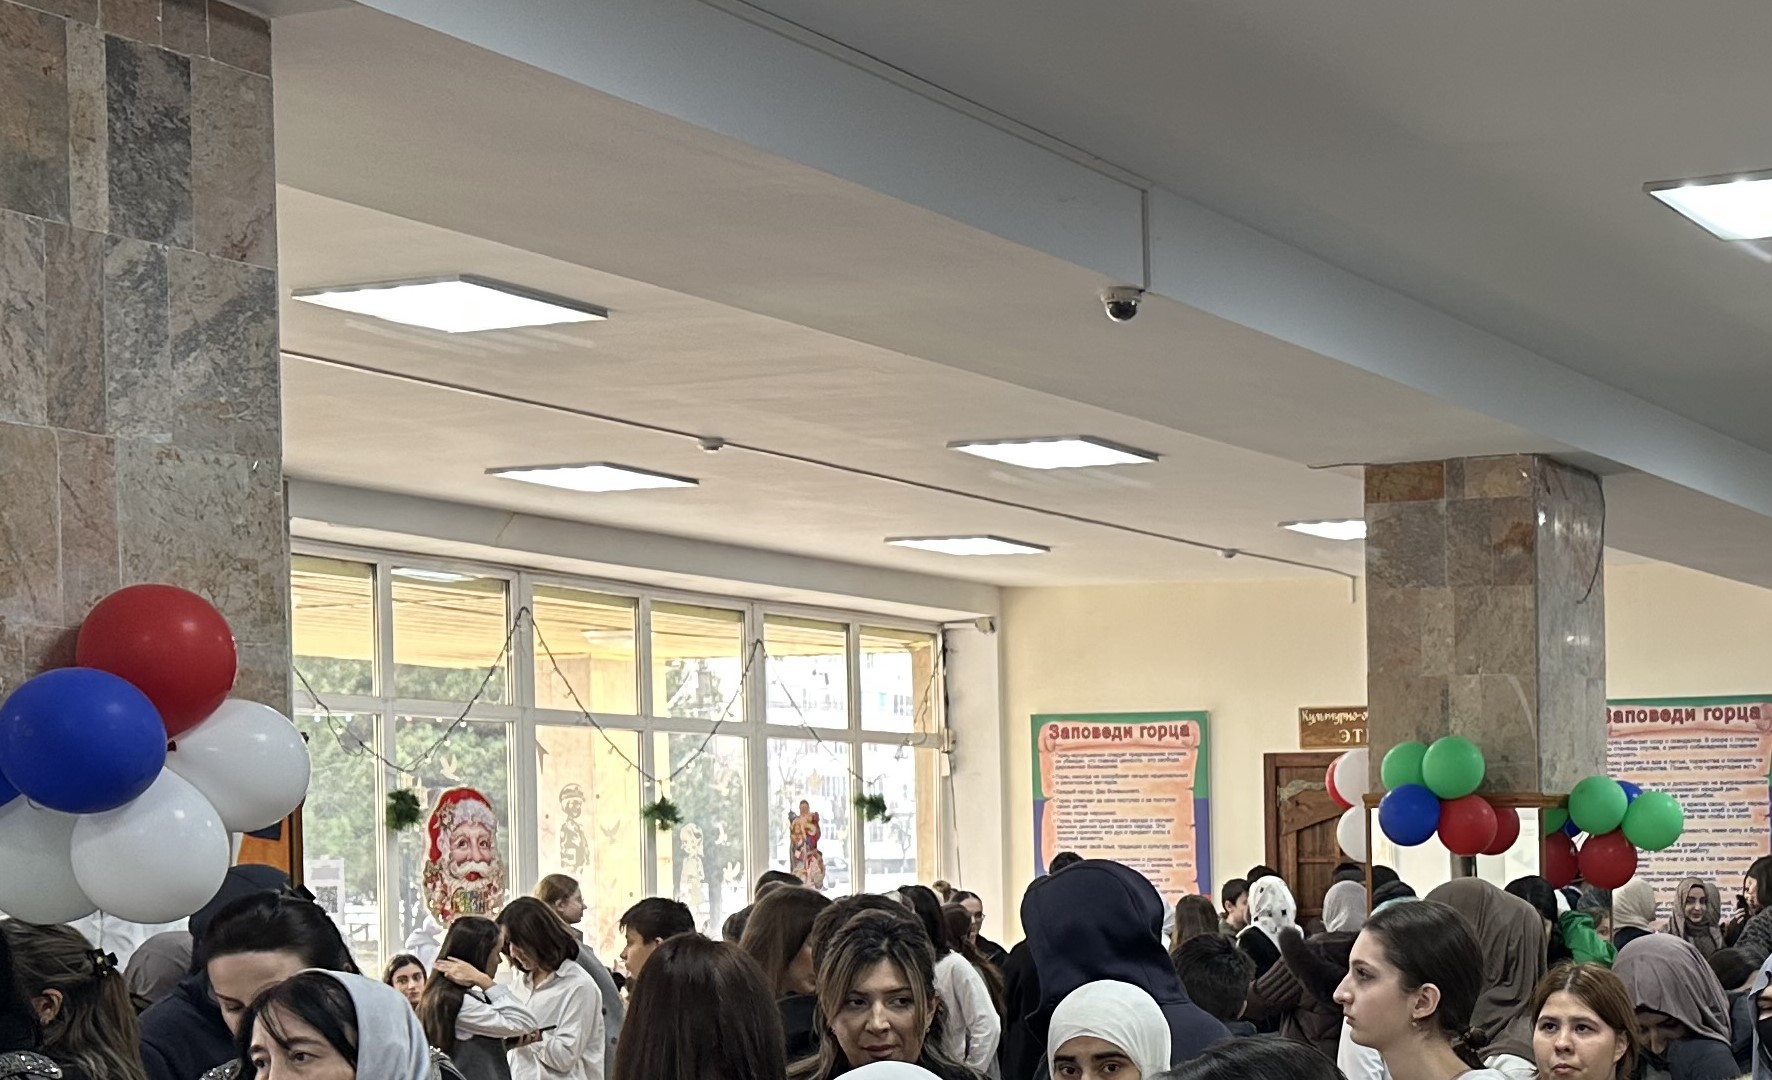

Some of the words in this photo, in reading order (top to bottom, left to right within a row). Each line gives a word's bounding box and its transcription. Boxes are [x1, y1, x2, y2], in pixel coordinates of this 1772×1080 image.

[1703, 705, 1761, 722] горца
[1049, 723, 1133, 741] Заповеди
[1140, 723, 1191, 741] горца
